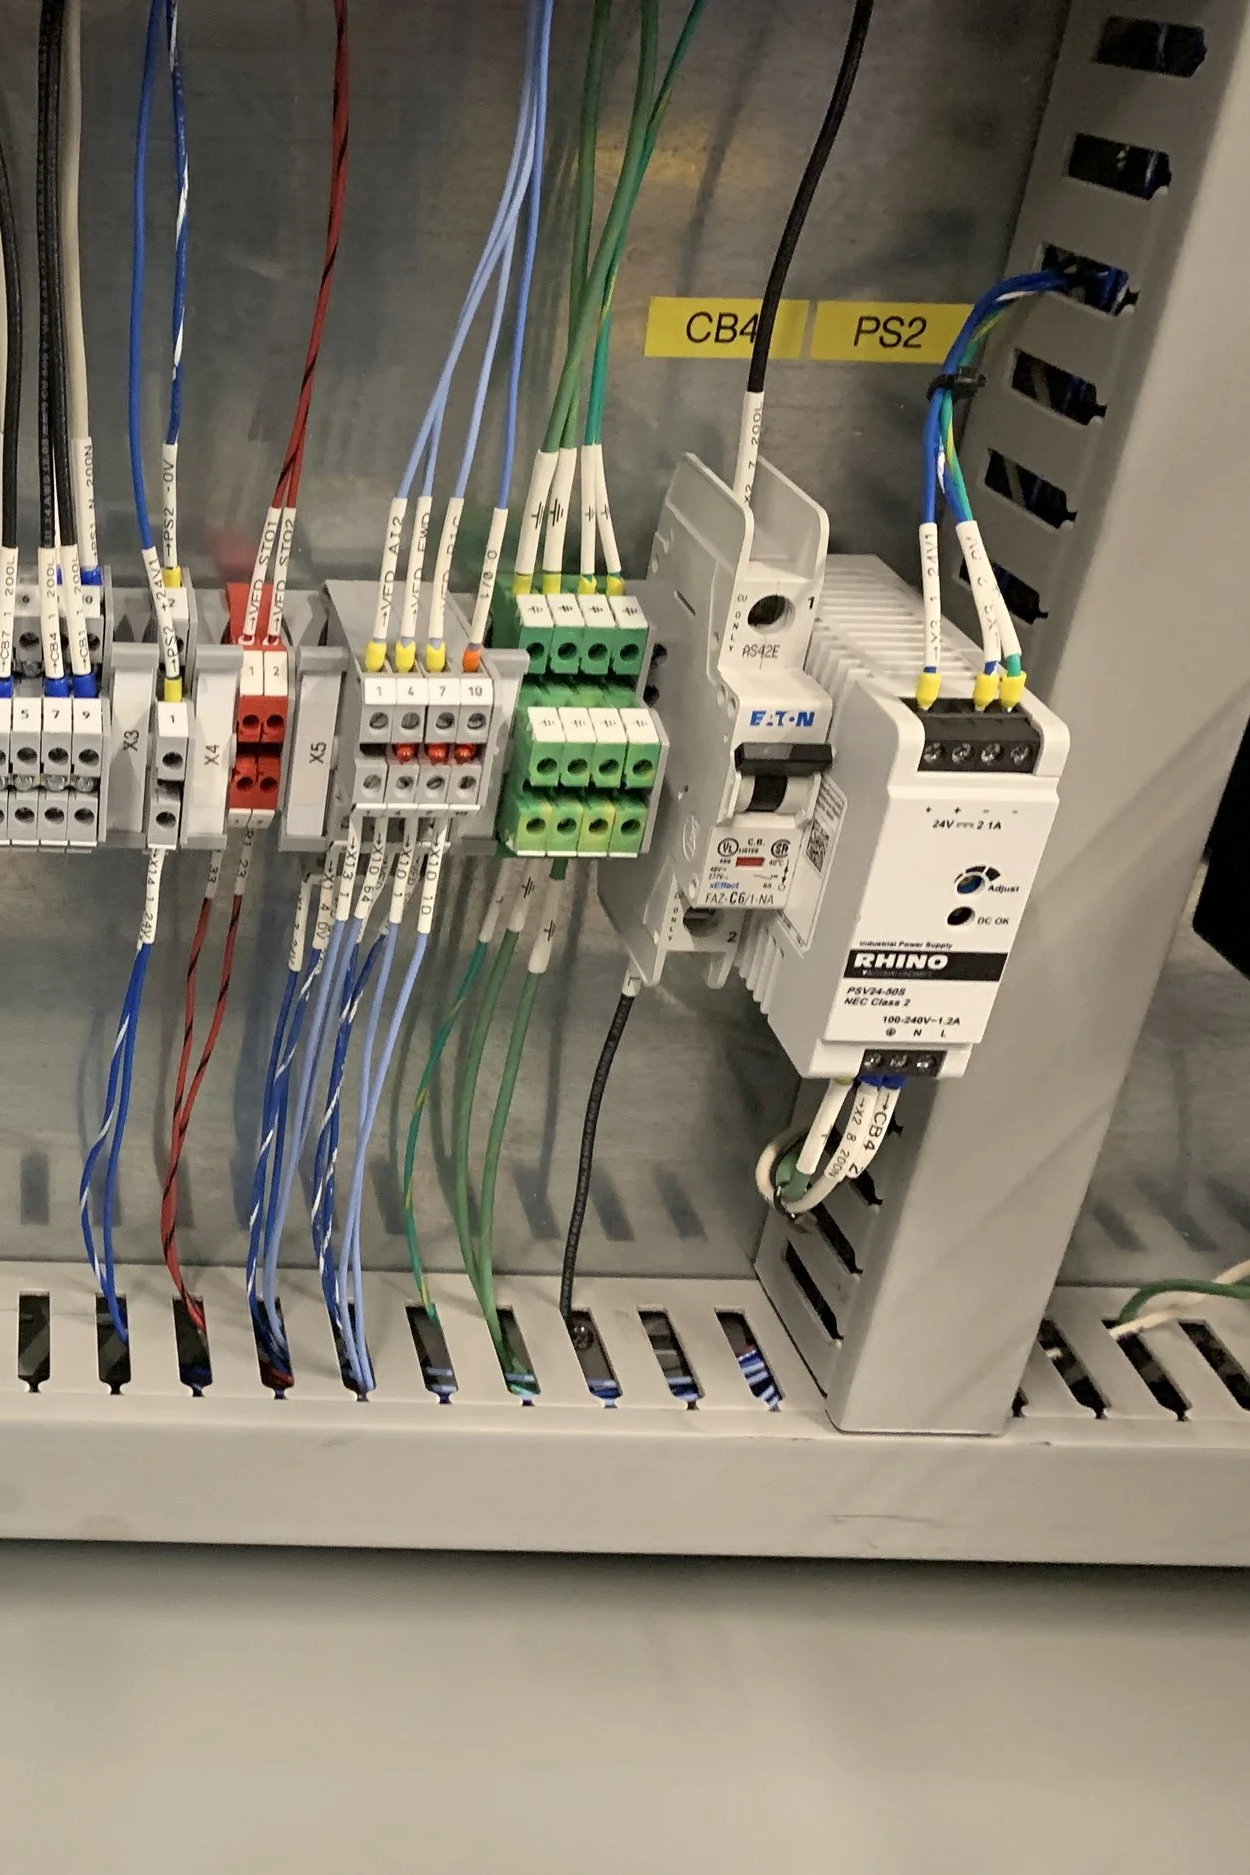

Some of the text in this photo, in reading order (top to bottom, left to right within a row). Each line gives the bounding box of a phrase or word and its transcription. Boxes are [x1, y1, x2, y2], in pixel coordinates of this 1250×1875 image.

[685, 311, 760, 345] CB4
[852, 315, 928, 349] PS2
[163, 507, 175, 541] PS2
[279, 519, 294, 566] STO2
[388, 515, 403, 556] AI2
[259, 521, 278, 566] STO1
[46, 558, 56, 598] 200L
[71, 557, 82, 594] 200L
[22, 595, 30, 604] 6
[808, 596, 815, 610] 1
[0, 630, 10, 659] CB7
[5, 556, 15, 596] 200L
[728, 611, 742, 652] ONLY
[50, 633, 60, 661] CB4
[79, 629, 89, 657] CB1
[163, 626, 178, 658] PS2
[742, 644, 781, 659] AS42E
[248, 666, 255, 676] 1
[273, 666, 280, 676] 2
[377, 686, 382, 696] 1
[407, 686, 414, 696] 4
[439, 686, 446, 696] 7
[468, 686, 483, 696] 10
[21, 710, 29, 719] 5
[52, 709, 60, 719] 7
[82, 711, 90, 720] 9
[169, 714, 175, 723] 1
[123, 729, 140, 752] X3
[204, 744, 219, 766] X4
[309, 741, 326, 764] X5
[932, 820, 955, 829] 24V
[340, 850, 357, 899] X13 1
[361, 885, 374, 902] 64
[988, 884, 1019, 894] Adjust
[320, 902, 330, 911] 4
[977, 917, 1010, 925] DC OK
[727, 931, 737, 943] 2
[925, 941, 953, 950] Supply
[854, 952, 948, 970] RHINO
[628, 976, 640, 986] L
[844, 997, 911, 1007] NEC Class 2
[913, 1028, 922, 1037] N
[940, 1029, 946, 1038] L
[863, 1111, 887, 1151] CB4
[828, 1106, 864, 1177] X2 8 200N
